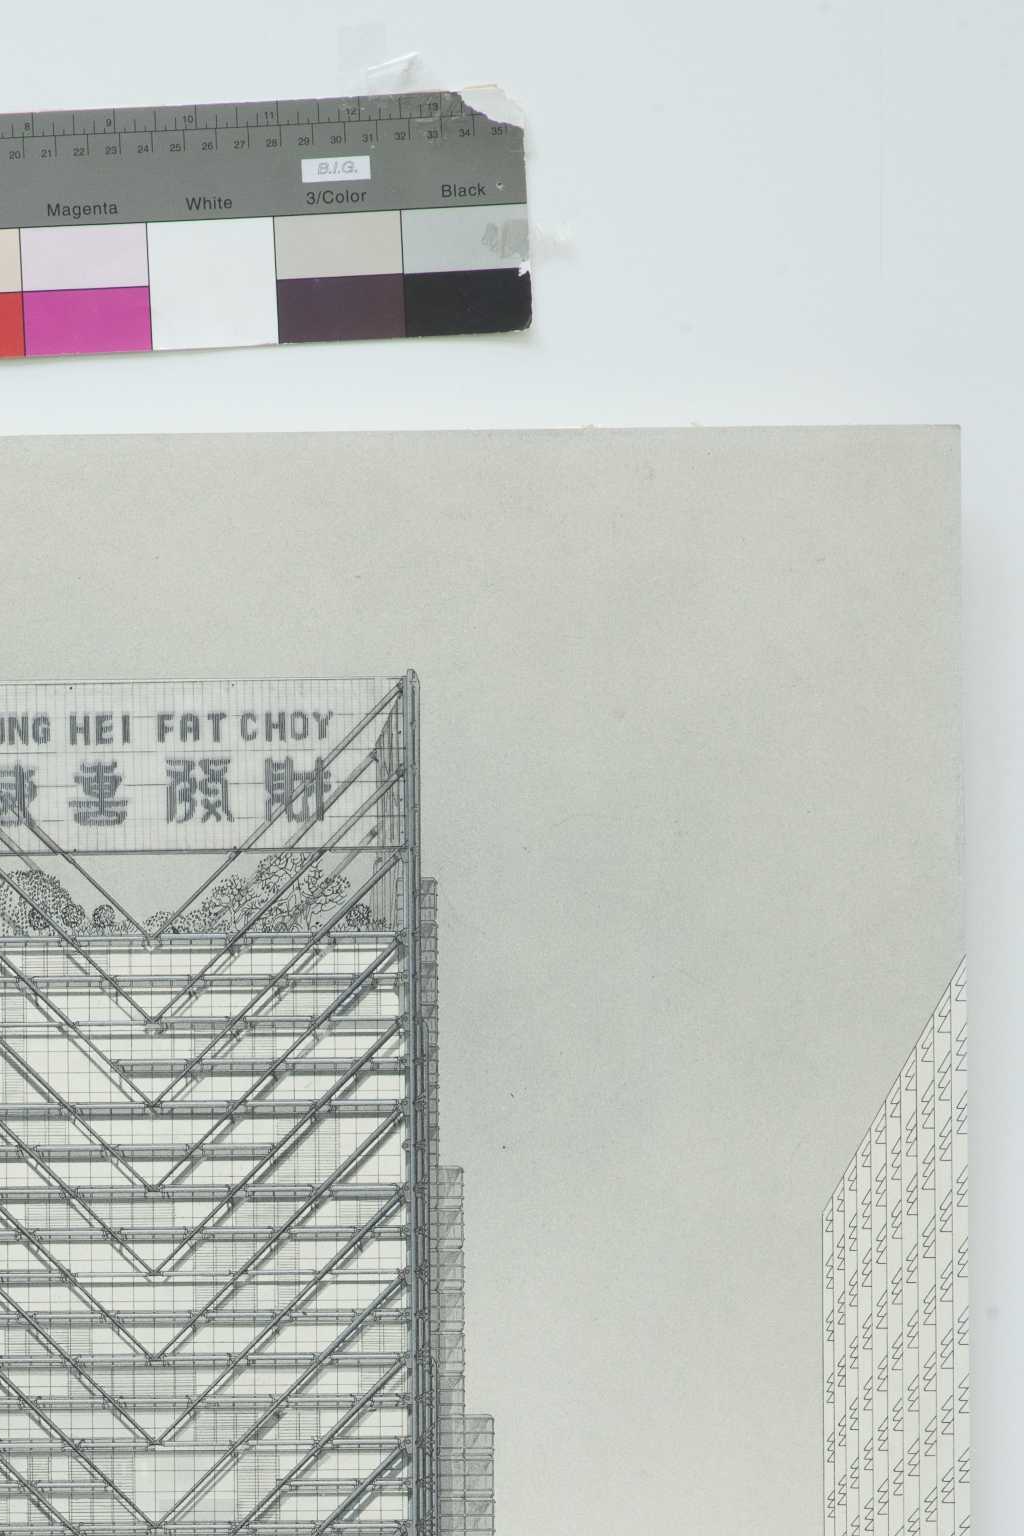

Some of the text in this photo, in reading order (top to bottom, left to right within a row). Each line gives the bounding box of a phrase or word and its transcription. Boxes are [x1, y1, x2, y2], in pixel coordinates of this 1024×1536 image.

[9, 151, 21, 159] 20
[41, 150, 52, 158] 21
[73, 148, 85, 156] 22
[105, 147, 117, 155] 23
[137, 145, 149, 153] 24
[169, 144, 182, 152] 25
[201, 142, 213, 150] 26
[234, 140, 245, 148] 27
[266, 138, 277, 147] 28
[298, 137, 310, 146] 29
[330, 135, 342, 144] 30
[362, 134, 373, 143] 31
[394, 132, 406, 141] 32
[427, 130, 438, 139] 33
[459, 128, 470, 137] 34
[491, 126, 503, 135] 35
[47, 201, 119, 219] Magenta
[185, 196, 233, 211] White
[306, 190, 367, 206] 3/Color
[441, 183, 487, 198] Black
[69, 712, 131, 746] HEI
[157, 711, 227, 744] FAT
[240, 711, 333, 743] CHOY
